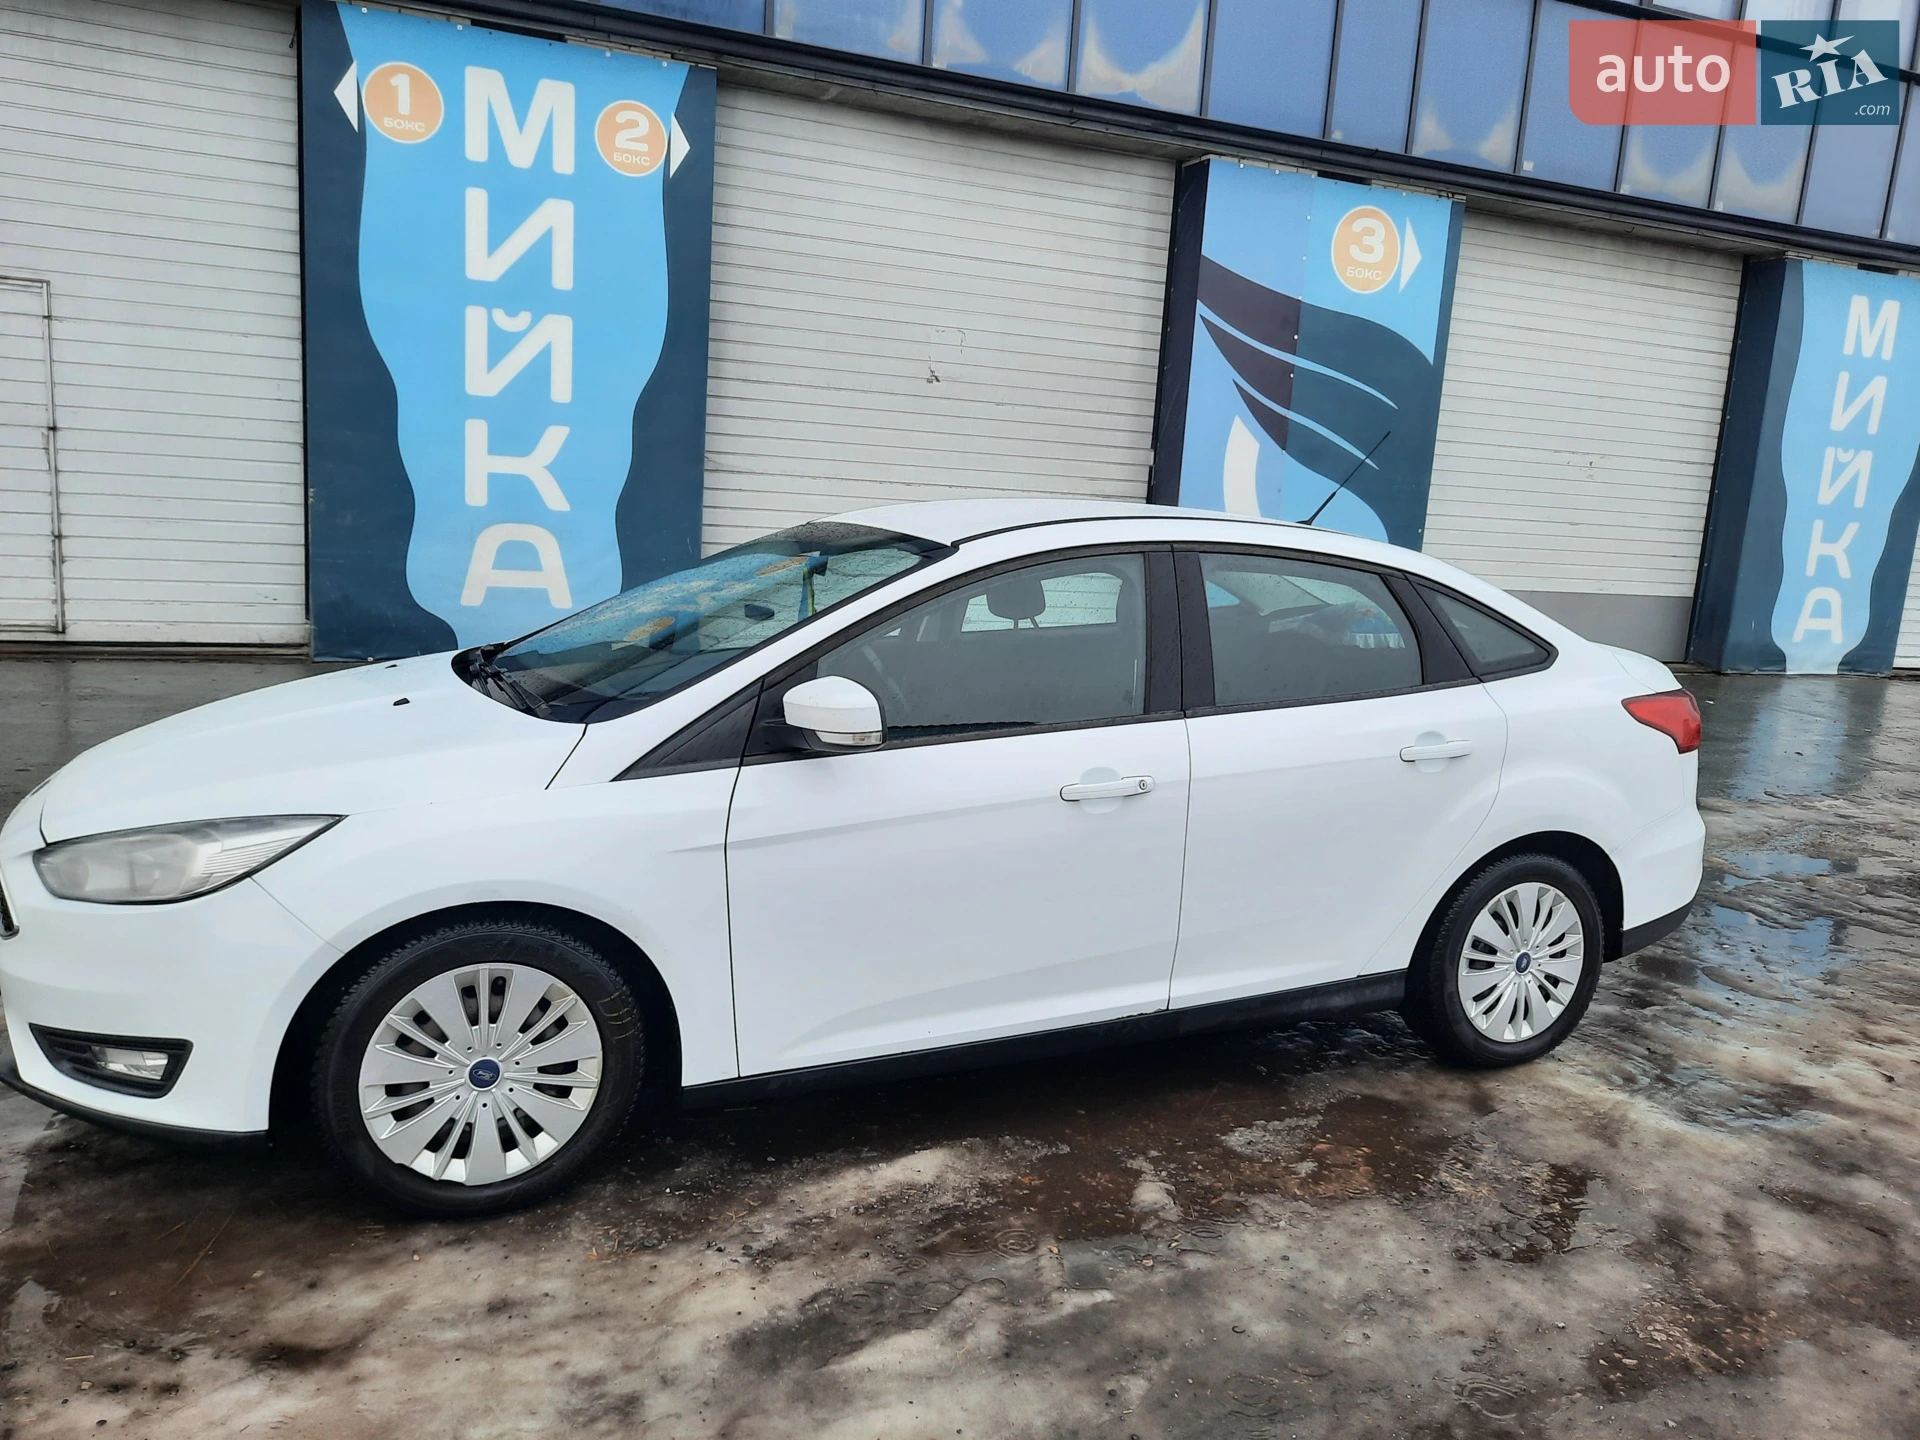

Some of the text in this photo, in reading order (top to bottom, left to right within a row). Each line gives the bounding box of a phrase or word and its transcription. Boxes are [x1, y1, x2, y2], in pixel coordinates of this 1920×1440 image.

[389, 73, 410, 115] 1
[383, 117, 425, 132] БОКС
[614, 110, 649, 152] 2
[613, 151, 650, 166] БОКС
[1349, 218, 1385, 263] 3
[1346, 266, 1382, 281] БОКС
[460, 65, 576, 609] МИЙКА
[1792, 294, 1900, 644] МИЙКА
